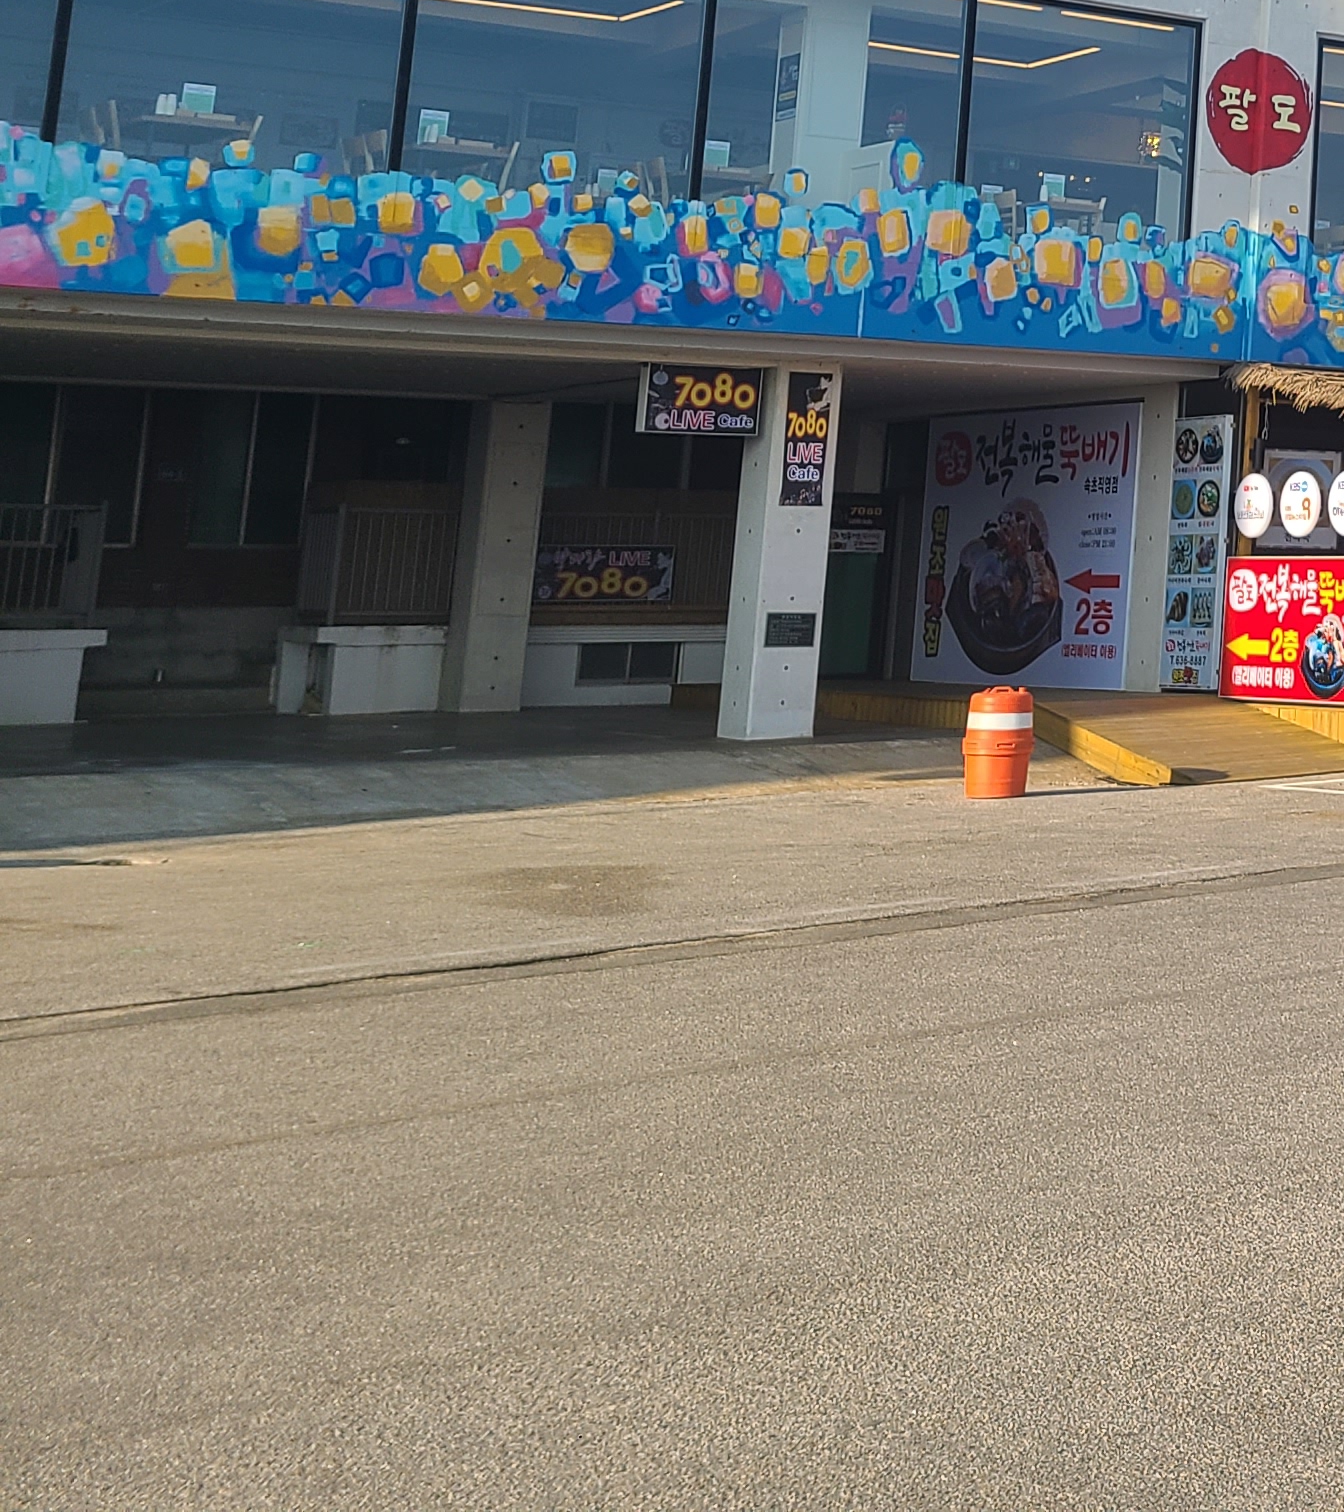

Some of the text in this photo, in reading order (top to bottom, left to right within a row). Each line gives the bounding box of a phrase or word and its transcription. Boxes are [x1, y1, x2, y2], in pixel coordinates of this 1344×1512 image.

[1218, 84, 1302, 133] 팔도
[674, 372, 756, 410] 7080
[670, 409, 754, 430] LIVE Cafe
[787, 408, 827, 438] 7080
[786, 442, 823, 463] LIVE
[787, 465, 820, 482] Cafe
[1084, 476, 1119, 495] 속초직영점
[608, 551, 651, 567] LIVE
[556, 567, 648, 599] 7080
[1074, 597, 1114, 636] 2층
[1269, 627, 1299, 663] 2층
